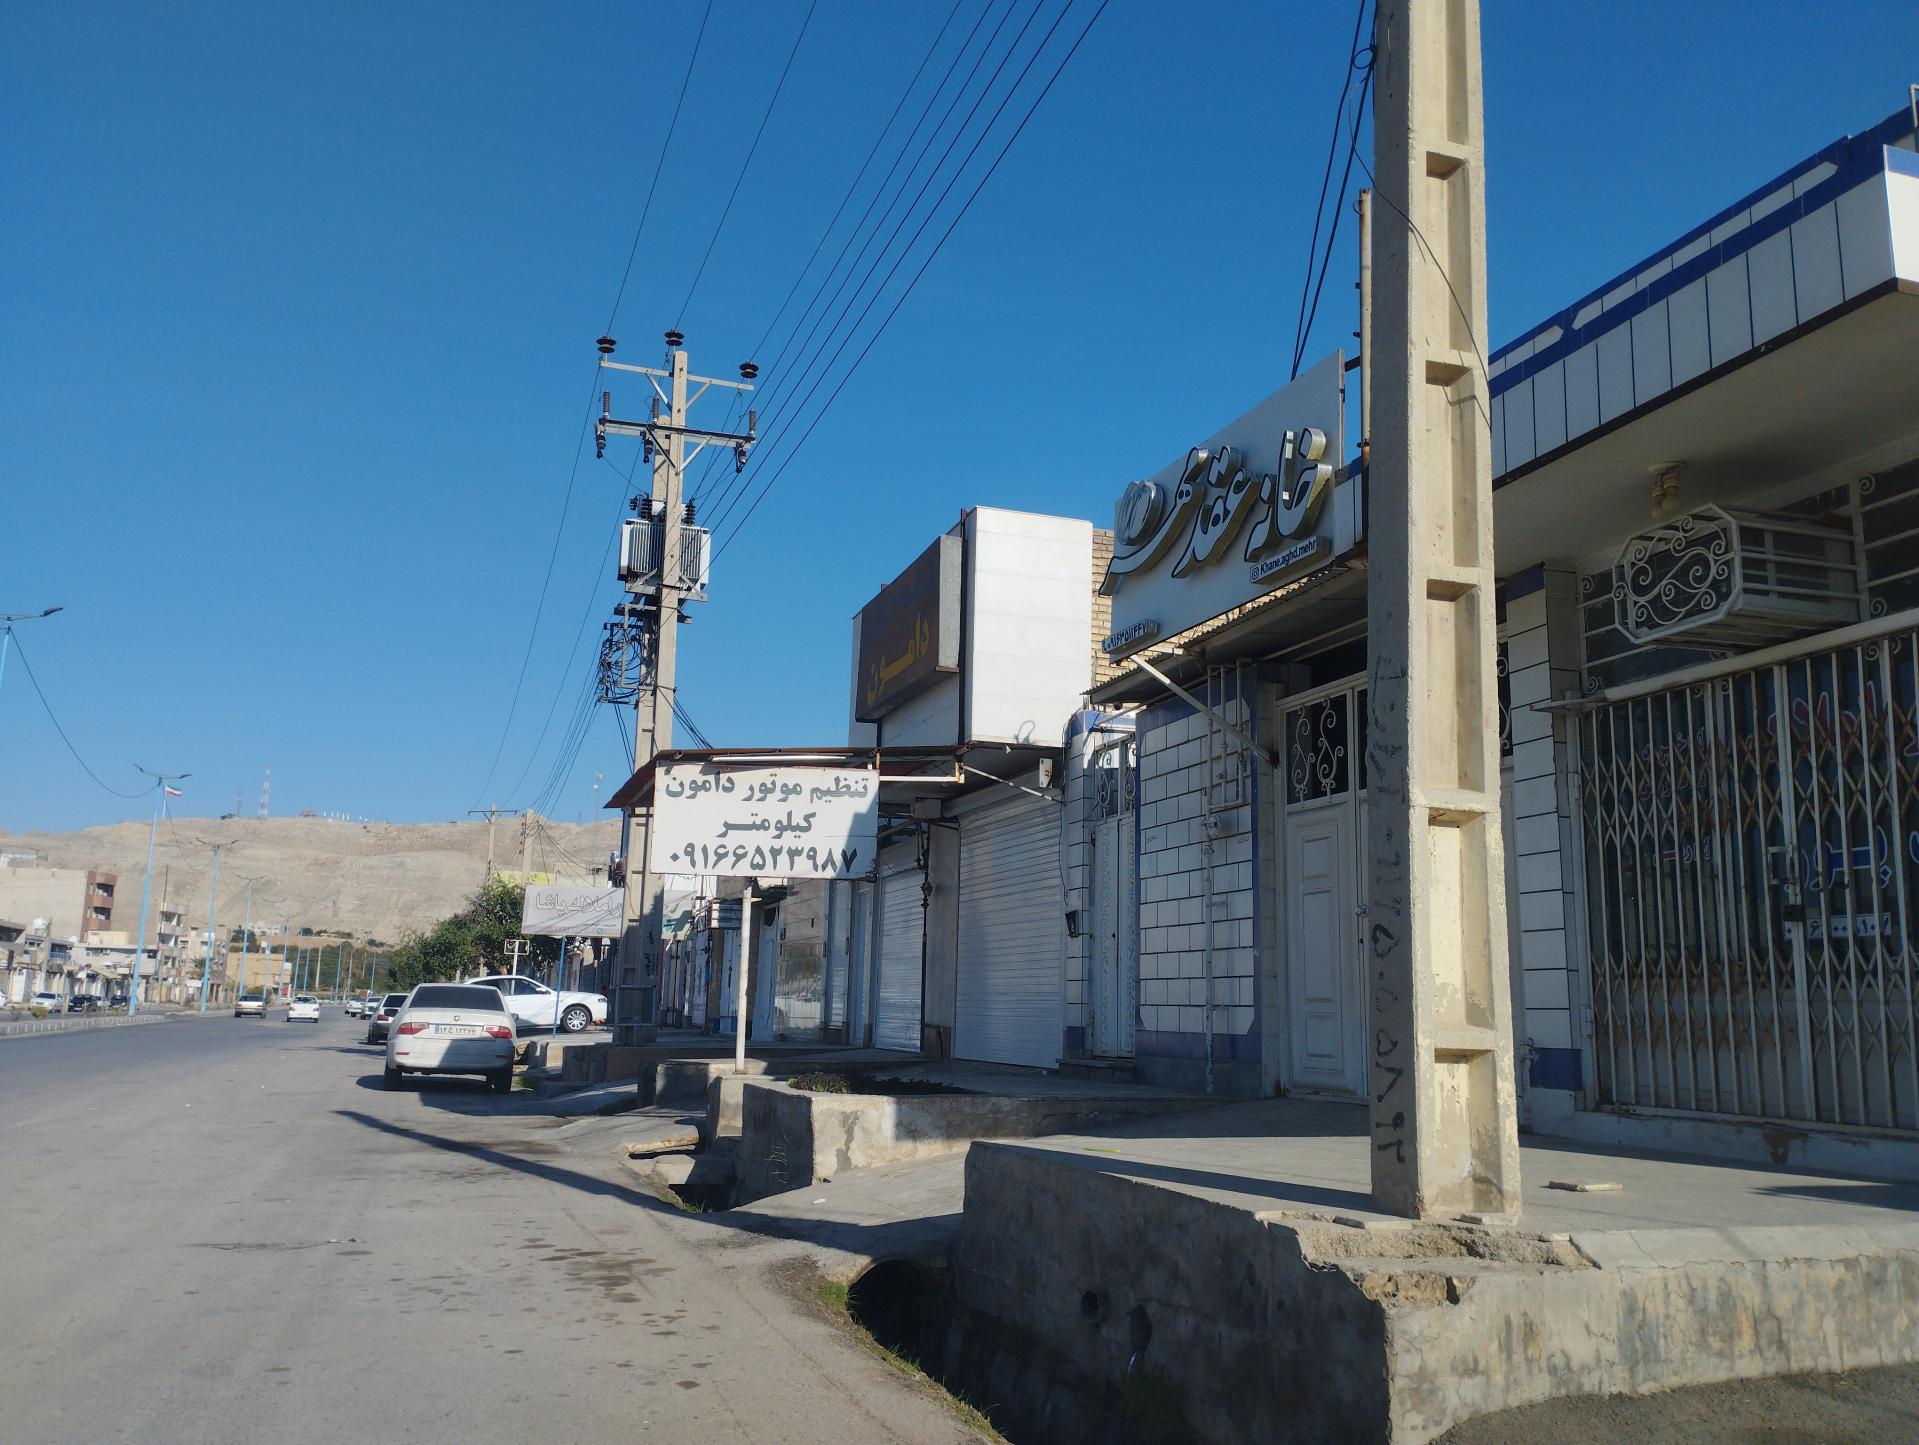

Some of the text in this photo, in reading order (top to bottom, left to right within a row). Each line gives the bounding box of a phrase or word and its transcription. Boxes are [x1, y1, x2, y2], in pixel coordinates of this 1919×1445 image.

[666, 771, 868, 803] تنظیم موتور دامون
[716, 810, 816, 839] کیلومتر
[670, 842, 857, 873] ۰۹۱۶۶۵۲۳۹۸۷
